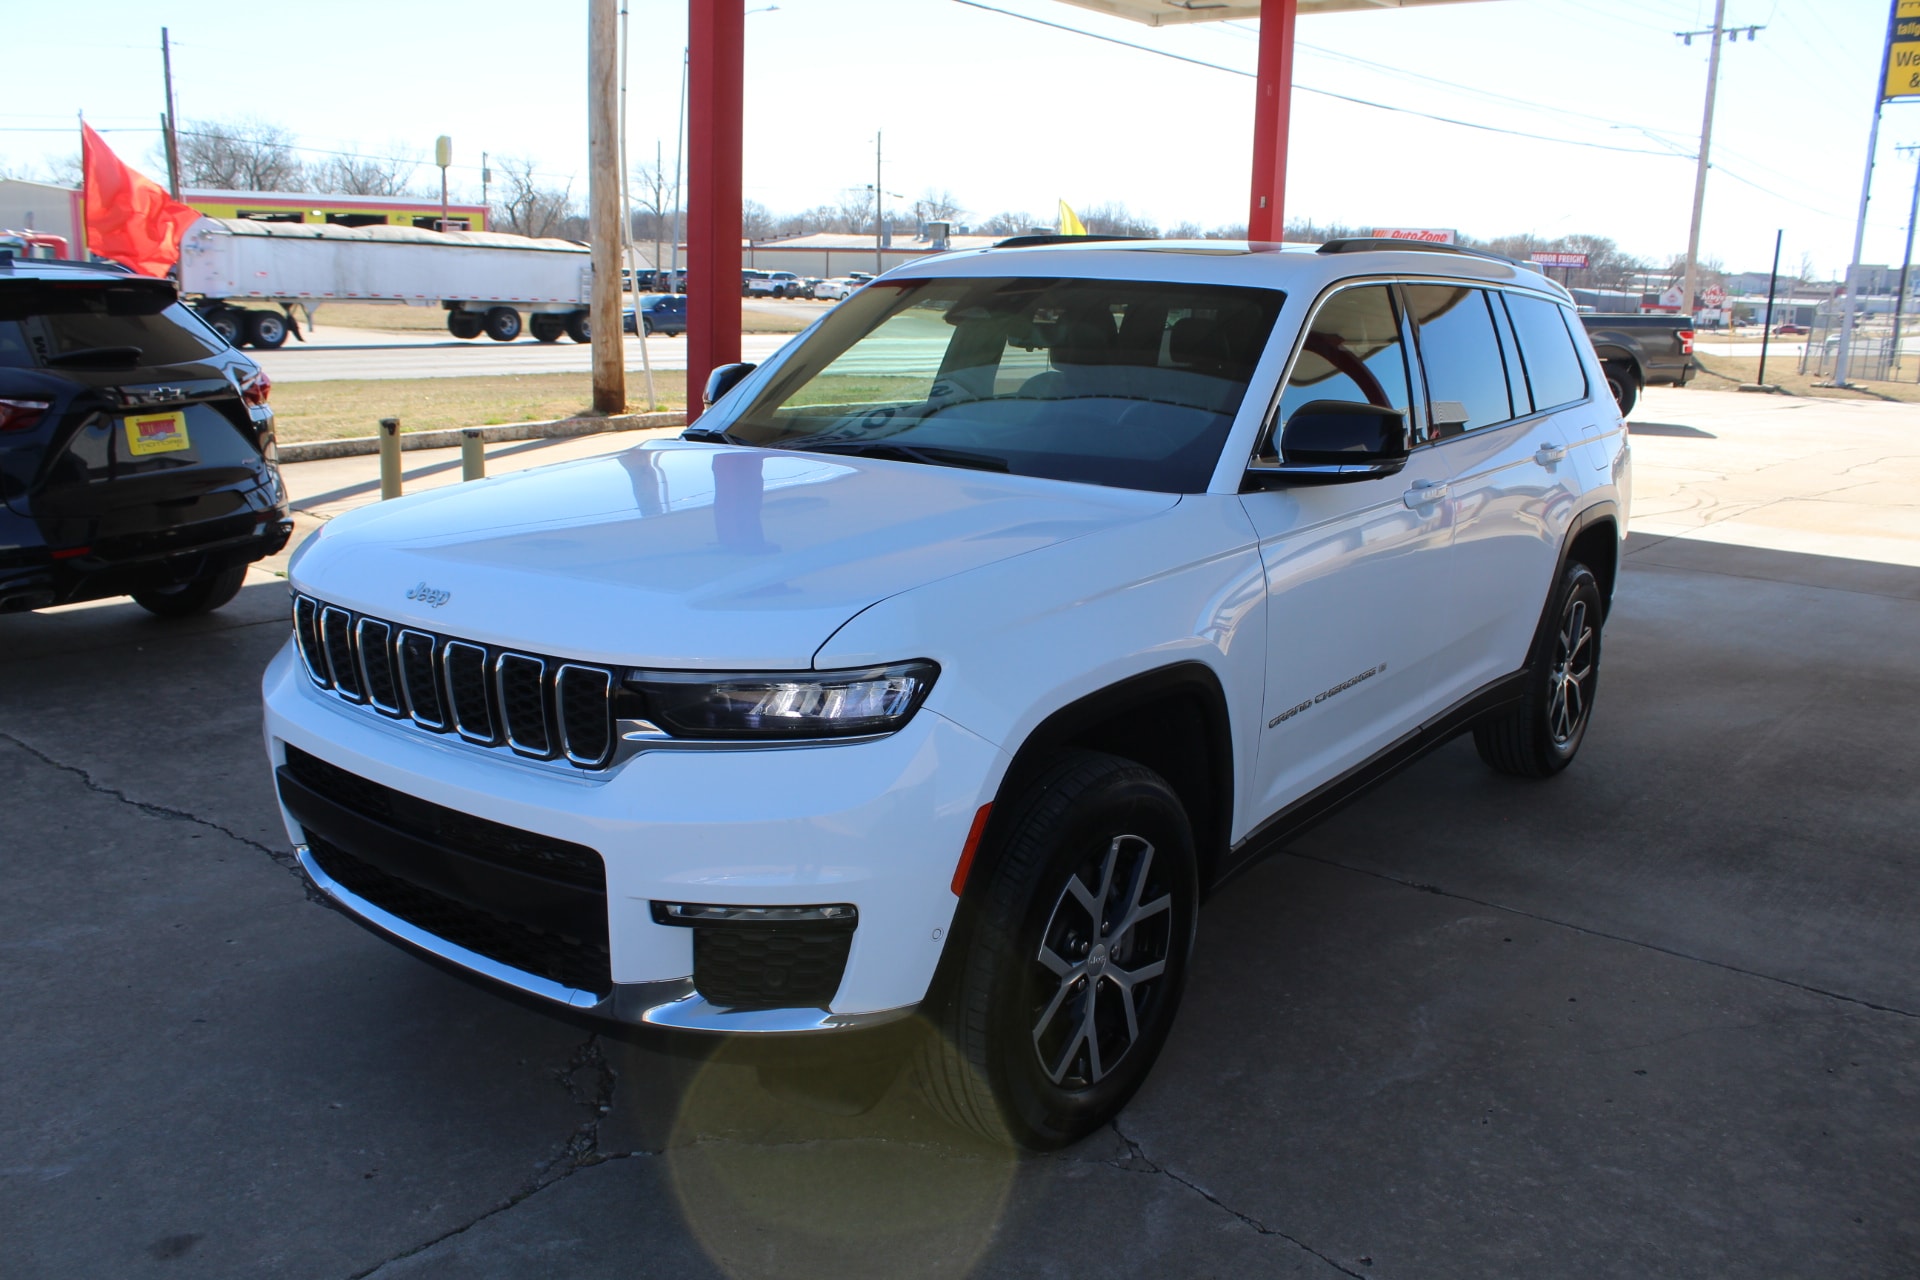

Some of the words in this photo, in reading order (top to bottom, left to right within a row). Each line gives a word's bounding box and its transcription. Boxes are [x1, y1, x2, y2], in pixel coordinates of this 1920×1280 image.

[1391, 230, 1448, 243] AutoZone
[1531, 253, 1557, 263] HARBOR
[1558, 254, 1586, 264] FREIGHT
[406, 581, 450, 608] Jeep
[1268, 699, 1312, 729] GRAND
[1314, 666, 1377, 704] CHEROKEE
